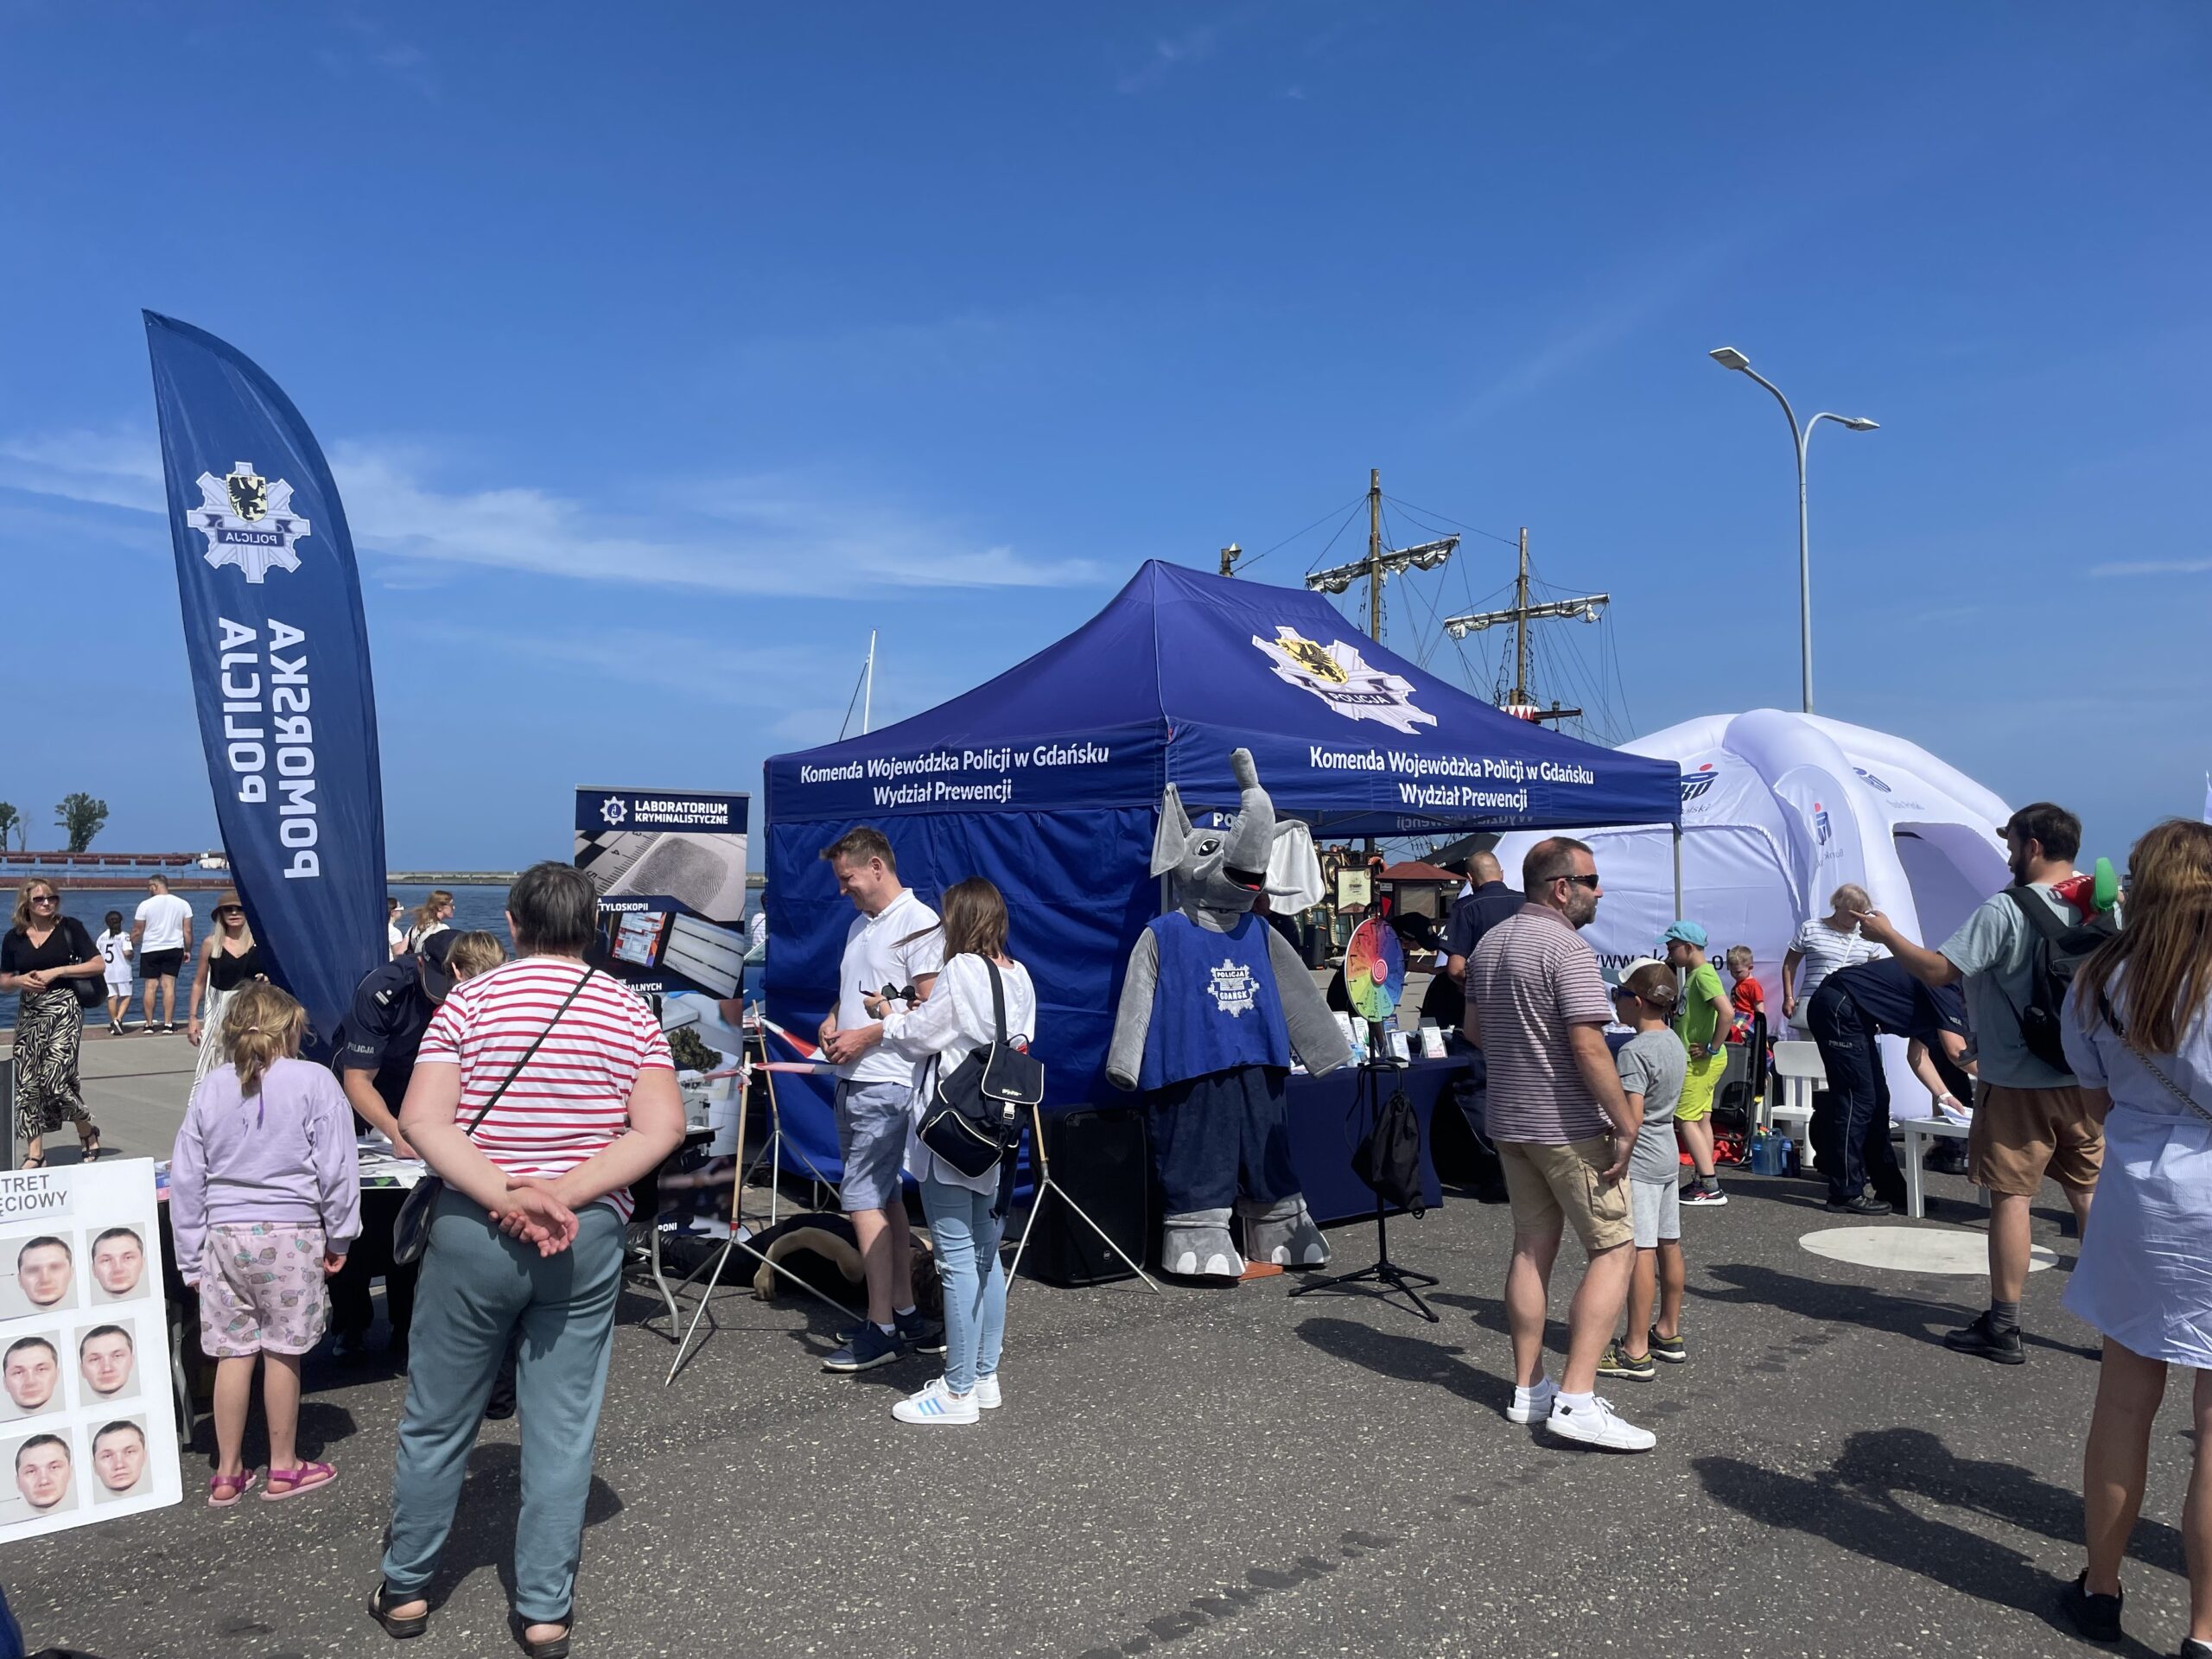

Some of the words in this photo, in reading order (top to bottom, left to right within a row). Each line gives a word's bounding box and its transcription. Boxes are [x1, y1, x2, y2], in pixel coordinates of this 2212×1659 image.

[1331, 693, 1391, 704] POLICJA
[800, 760, 863, 784] Komenda
[867, 751, 959, 780] Wojewódzka
[963, 747, 1011, 772] Policji
[1014, 752, 1029, 767] w
[1033, 742, 1109, 767] Gdańsku
[1310, 746, 1384, 771] Komenda
[1388, 751, 1482, 779] Wojewódzka
[1484, 759, 1524, 784] Policji
[1526, 766, 1538, 780] w
[1541, 762, 1594, 785] Gdańsku
[873, 781, 932, 808] Wydział
[935, 779, 1012, 804] Prewencji
[1398, 783, 1459, 808] Wydział
[1462, 787, 1528, 812] Prewencji
[634, 800, 728, 815] LABORATORIUM
[635, 813, 728, 825] KRYMINALISTYCZNE
[597, 903, 649, 912] TYLOSKOPII
[105, 944, 114, 963] 5
[347, 1042, 375, 1054] POLICJA
[1, 1174, 50, 1193] TRET
[0, 1191, 67, 1217] CIOWY
